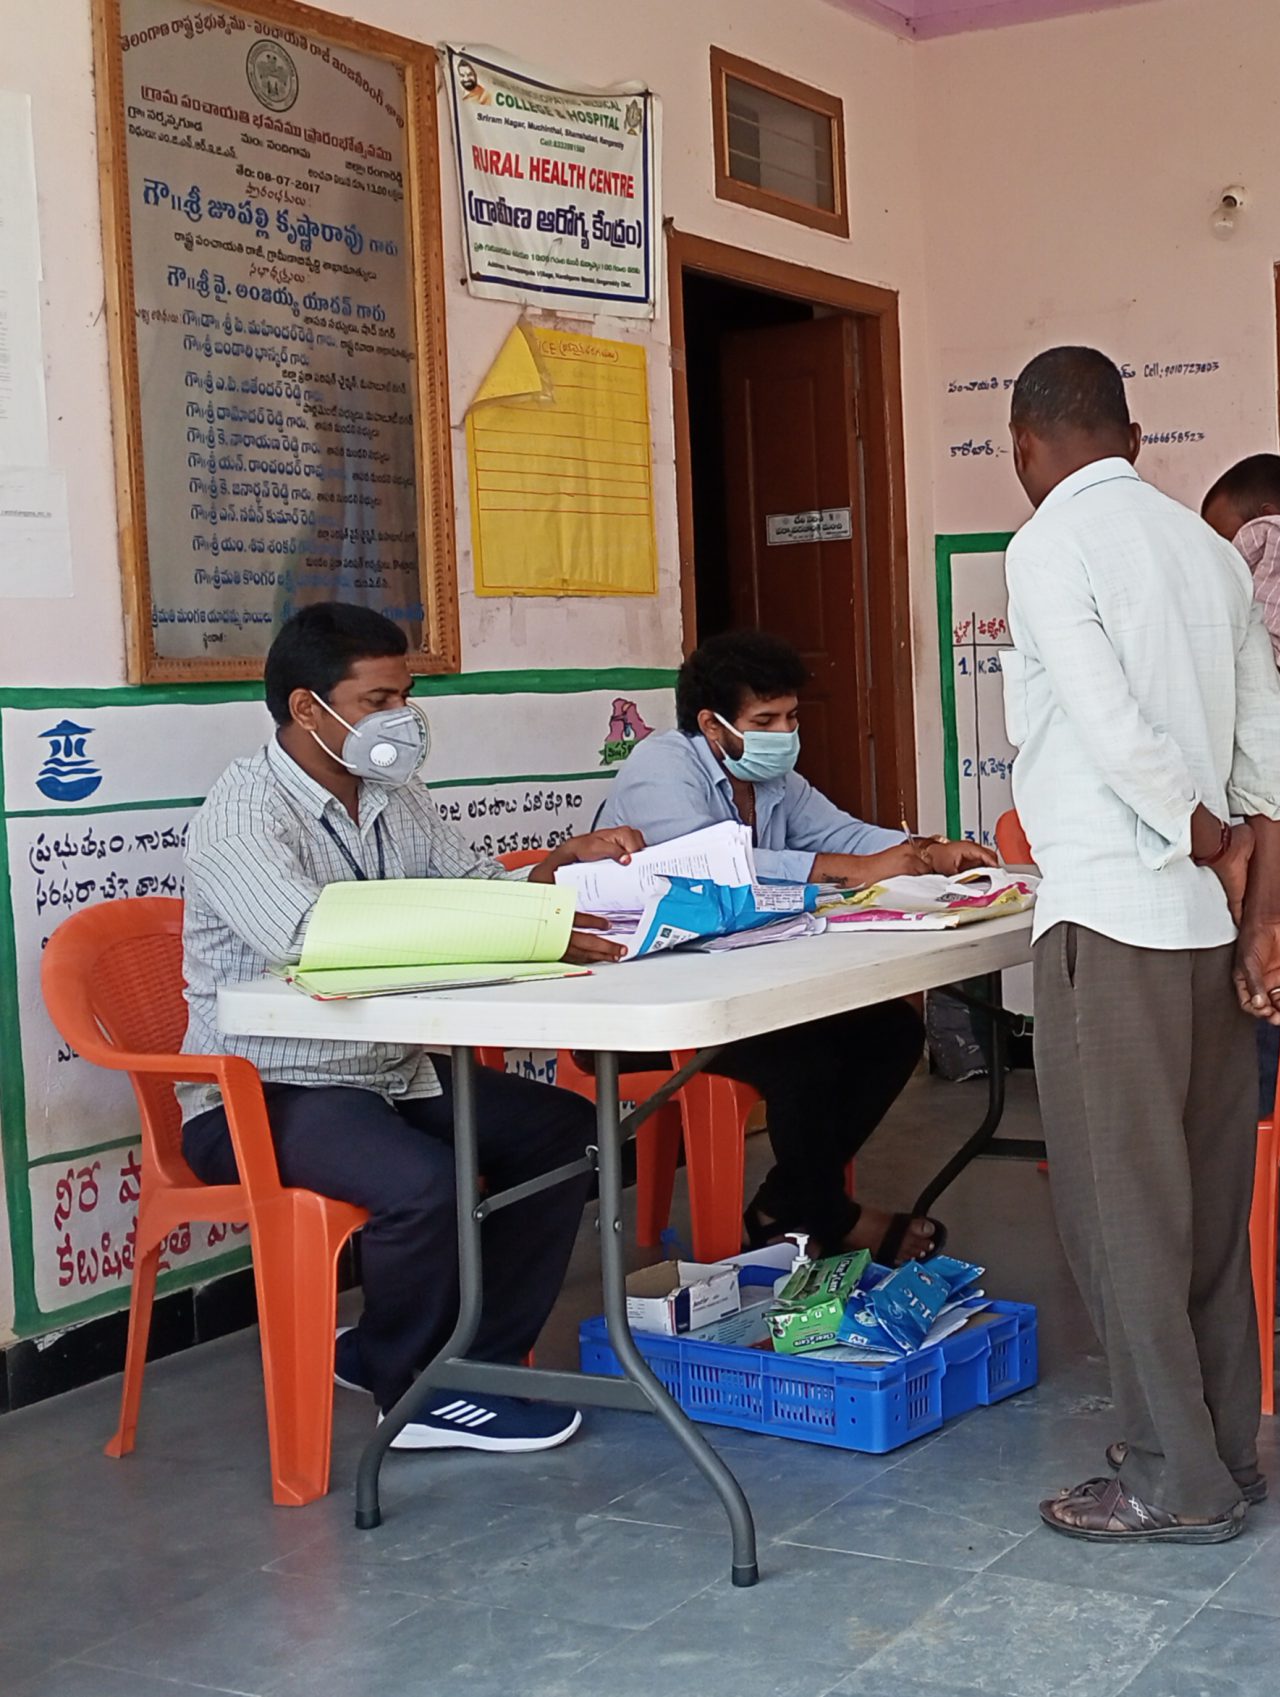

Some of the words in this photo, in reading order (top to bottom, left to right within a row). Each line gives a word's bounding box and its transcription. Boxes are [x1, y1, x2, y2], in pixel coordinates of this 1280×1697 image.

[141, 85, 178, 105] గ్రామ
[181, 94, 250, 124] పంచాయతి
[252, 114, 302, 138] భవనము
[303, 127, 393, 162] ప్రారంభోత్సవము
[477, 112, 504, 125] Sriram
[503, 117, 526, 131] Nagar,
[495, 92, 555, 118] COLLEGE
[565, 109, 621, 131] HOSPITAL
[256, 171, 321, 195] 08-07-2017
[471, 145, 525, 181] RURAL
[529, 156, 587, 191] HEALTH
[588, 167, 636, 200] CENTRE
[207, 199, 270, 239] జూపల్లి
[276, 209, 364, 255] కృష్ణారావు
[369, 238, 399, 257] గారు
[468, 190, 533, 230] (గ్రామీణ
[536, 204, 591, 251] ఆరోగ్య
[592, 209, 643, 250] కేంద్రం)
[236, 283, 301, 318] అంజయ్య
[303, 294, 352, 317] యాదవ్
[356, 303, 387, 322] గారు
[467, 797, 518, 819] లవణాలు
[36, 877, 96, 916] సరఫరా
